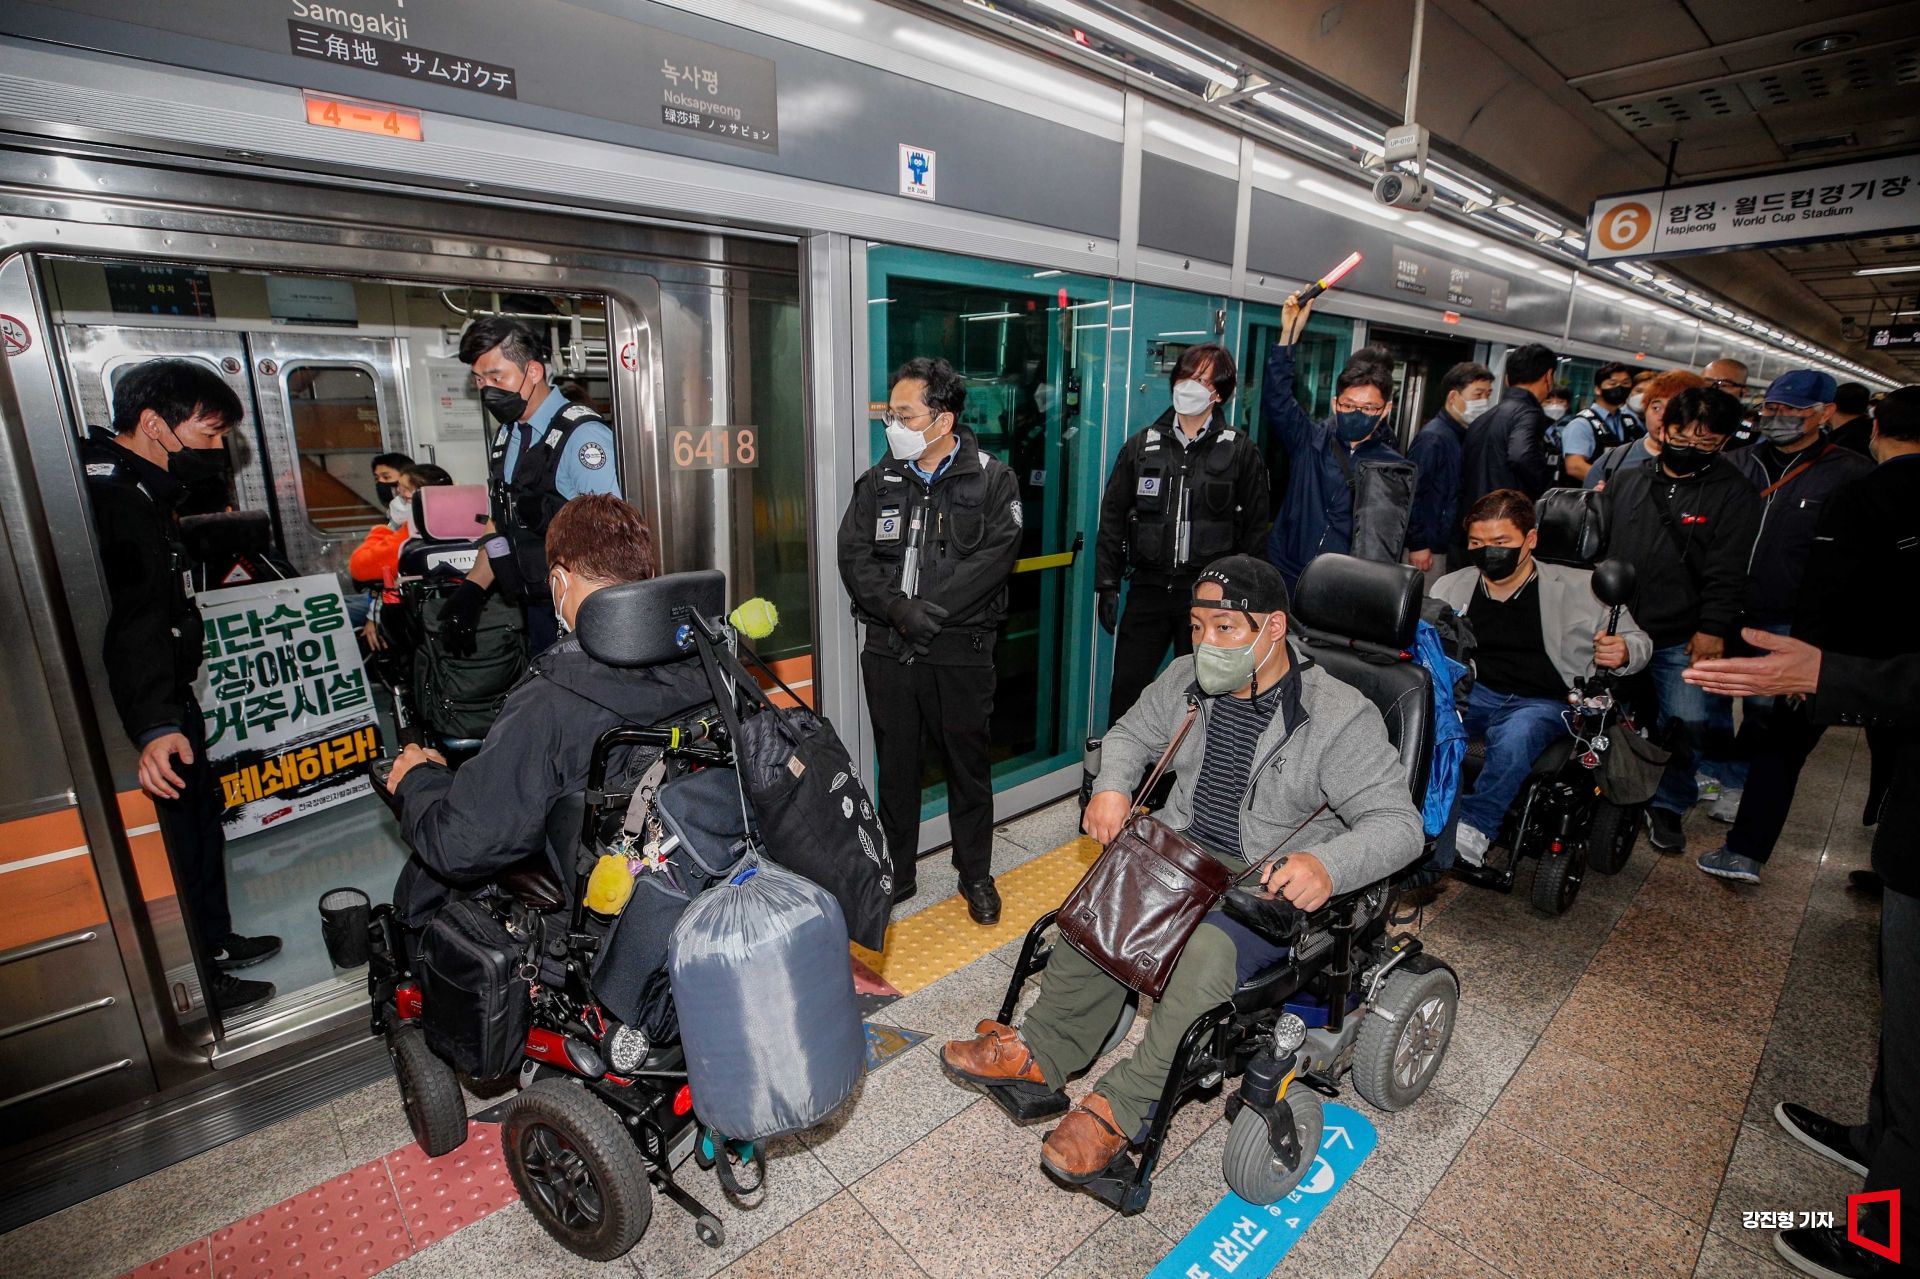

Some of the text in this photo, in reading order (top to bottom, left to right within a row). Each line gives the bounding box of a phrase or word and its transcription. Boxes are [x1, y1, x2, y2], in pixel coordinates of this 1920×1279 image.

[293, 0, 408, 41] Samgakji
[297, 28, 512, 92] 三角地 サムガクチ
[661, 59, 718, 95] 녹사평
[664, 89, 741, 120] Noksapyeong
[664, 108, 701, 128] 绿莎坪
[1610, 208, 1639, 244] 6
[1665, 205, 1854, 236] Hapjeong World Cup Stadium
[673, 429, 755, 467] 6418
[207, 634, 340, 702] 장애인
[203, 667, 368, 748] 거주시설
[219, 726, 378, 809] 폐쇄하라!
[1209, 1215, 1269, 1274] 진접
